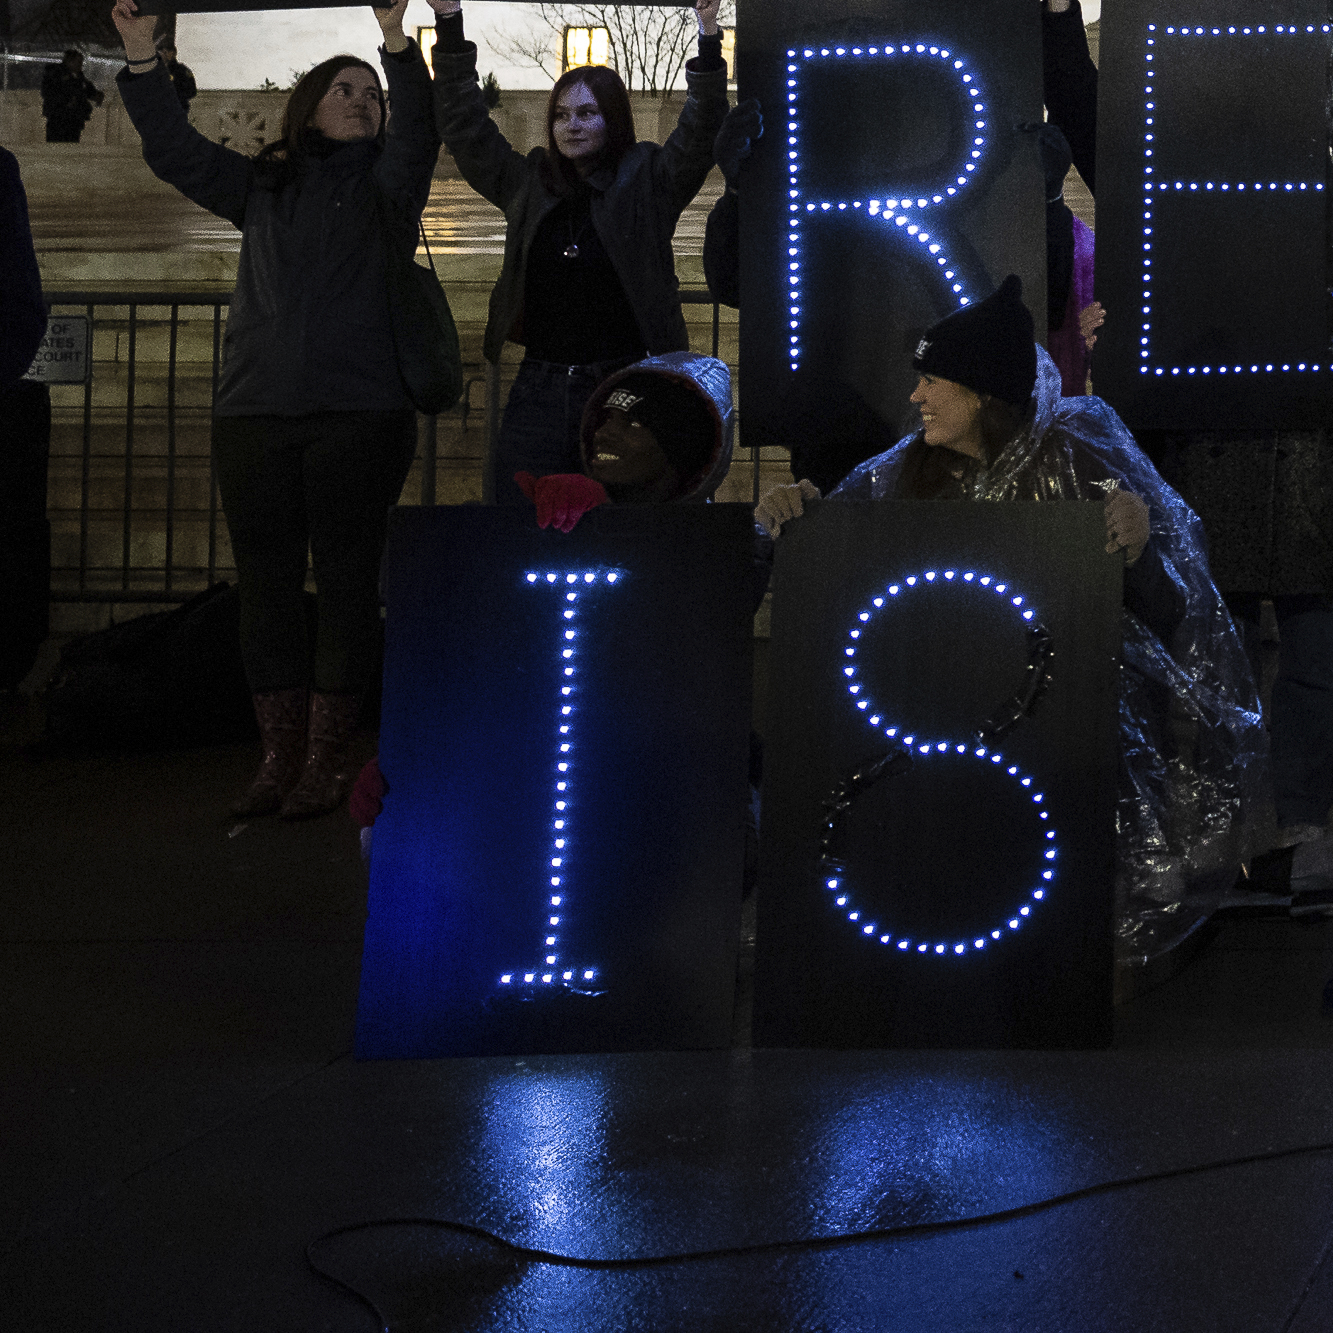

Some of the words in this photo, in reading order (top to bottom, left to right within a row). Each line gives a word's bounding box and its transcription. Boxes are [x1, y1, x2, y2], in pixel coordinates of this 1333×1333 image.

[50, 323, 72, 335] OF
[40, 337, 75, 349] ATES
[34, 350, 83, 363] COURT
[497, 568, 1060, 997] IS
